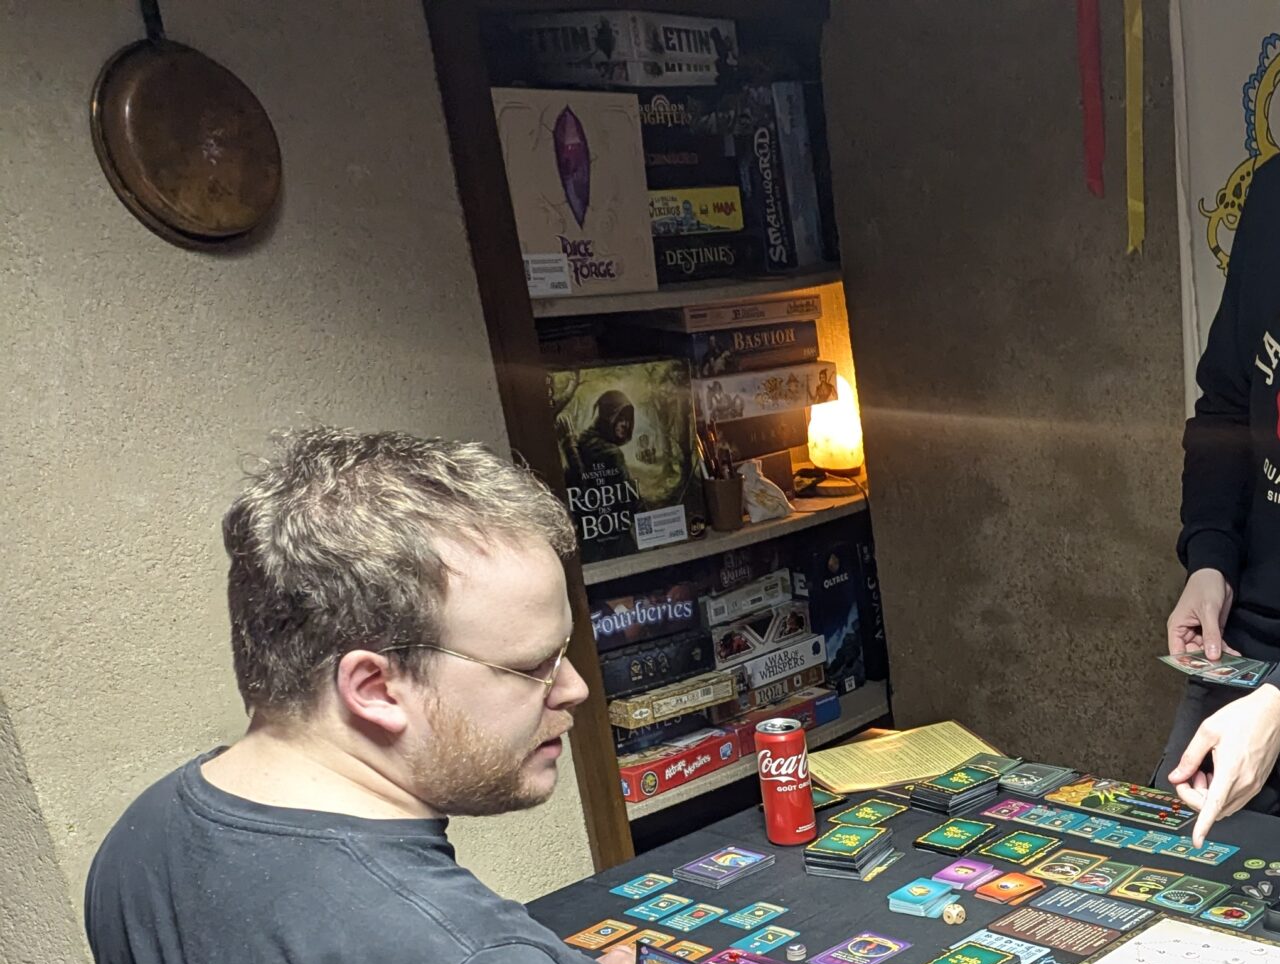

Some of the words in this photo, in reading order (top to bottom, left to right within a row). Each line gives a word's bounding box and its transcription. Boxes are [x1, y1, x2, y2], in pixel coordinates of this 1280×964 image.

[663, 26, 711, 53] ETTIN
[555, 235, 594, 257] DICE
[568, 259, 616, 287] FORGE
[666, 246, 735, 274] DESTINIES
[733, 328, 796, 351] BASTION
[593, 462, 606, 471] LES
[566, 479, 641, 512] ROBIN
[581, 510, 632, 540] BOIS
[590, 597, 693, 640] Fourberies
[759, 655, 806, 680] WHISPERS
[768, 650, 790, 667] WAR
[776, 783, 797, 792] GOÛT
